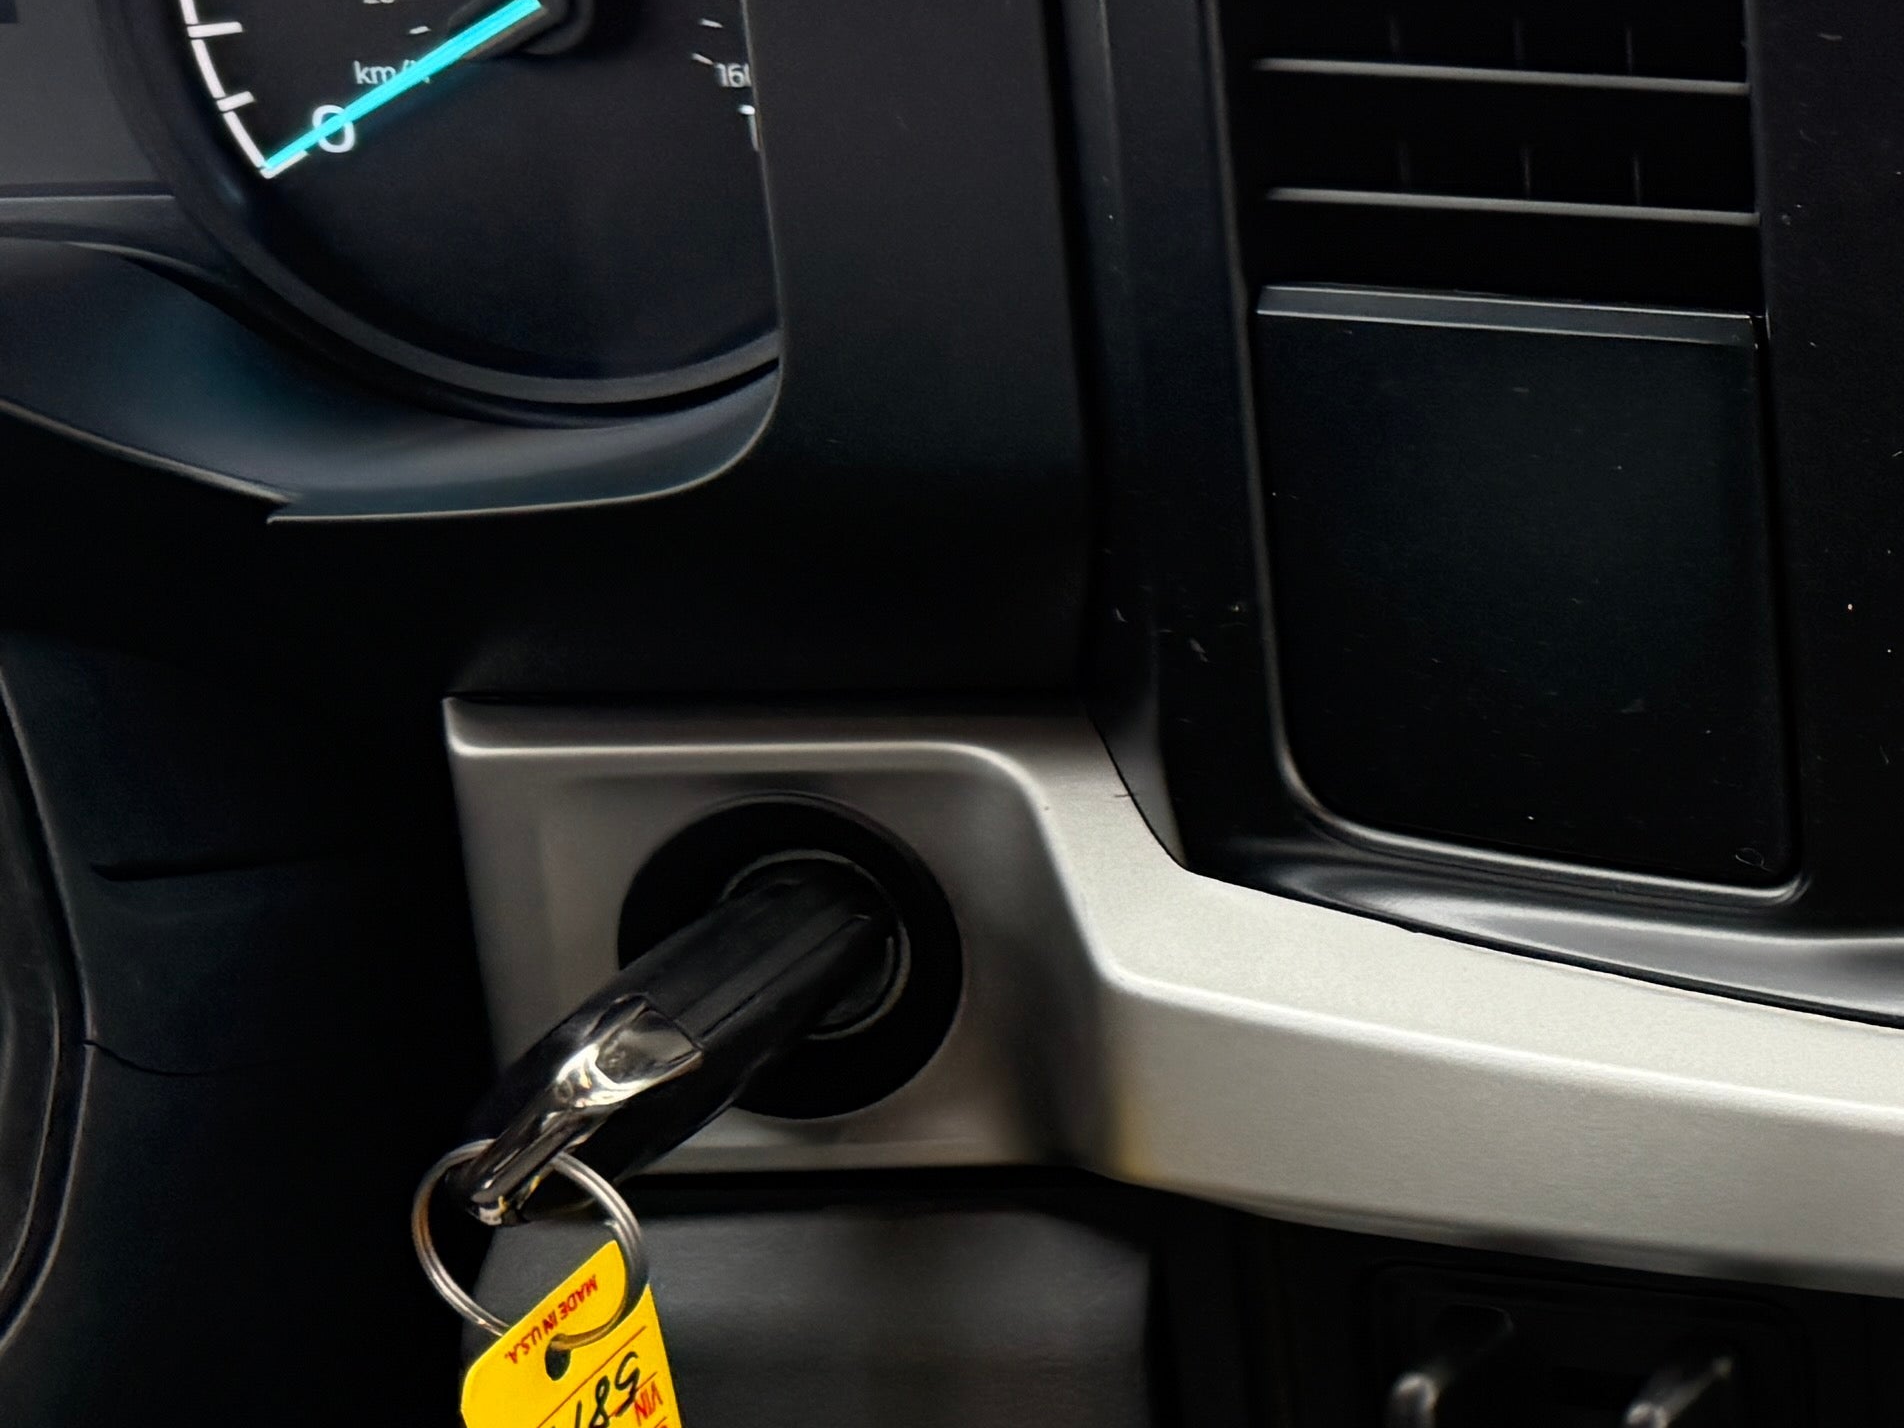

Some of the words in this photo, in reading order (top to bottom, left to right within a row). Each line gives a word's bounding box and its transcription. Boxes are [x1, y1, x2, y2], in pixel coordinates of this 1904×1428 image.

[312, 105, 357, 152] 0
[557, 1275, 598, 1321] MADE
[541, 1310, 559, 1335] IN
[633, 1381, 663, 1426] VIN
